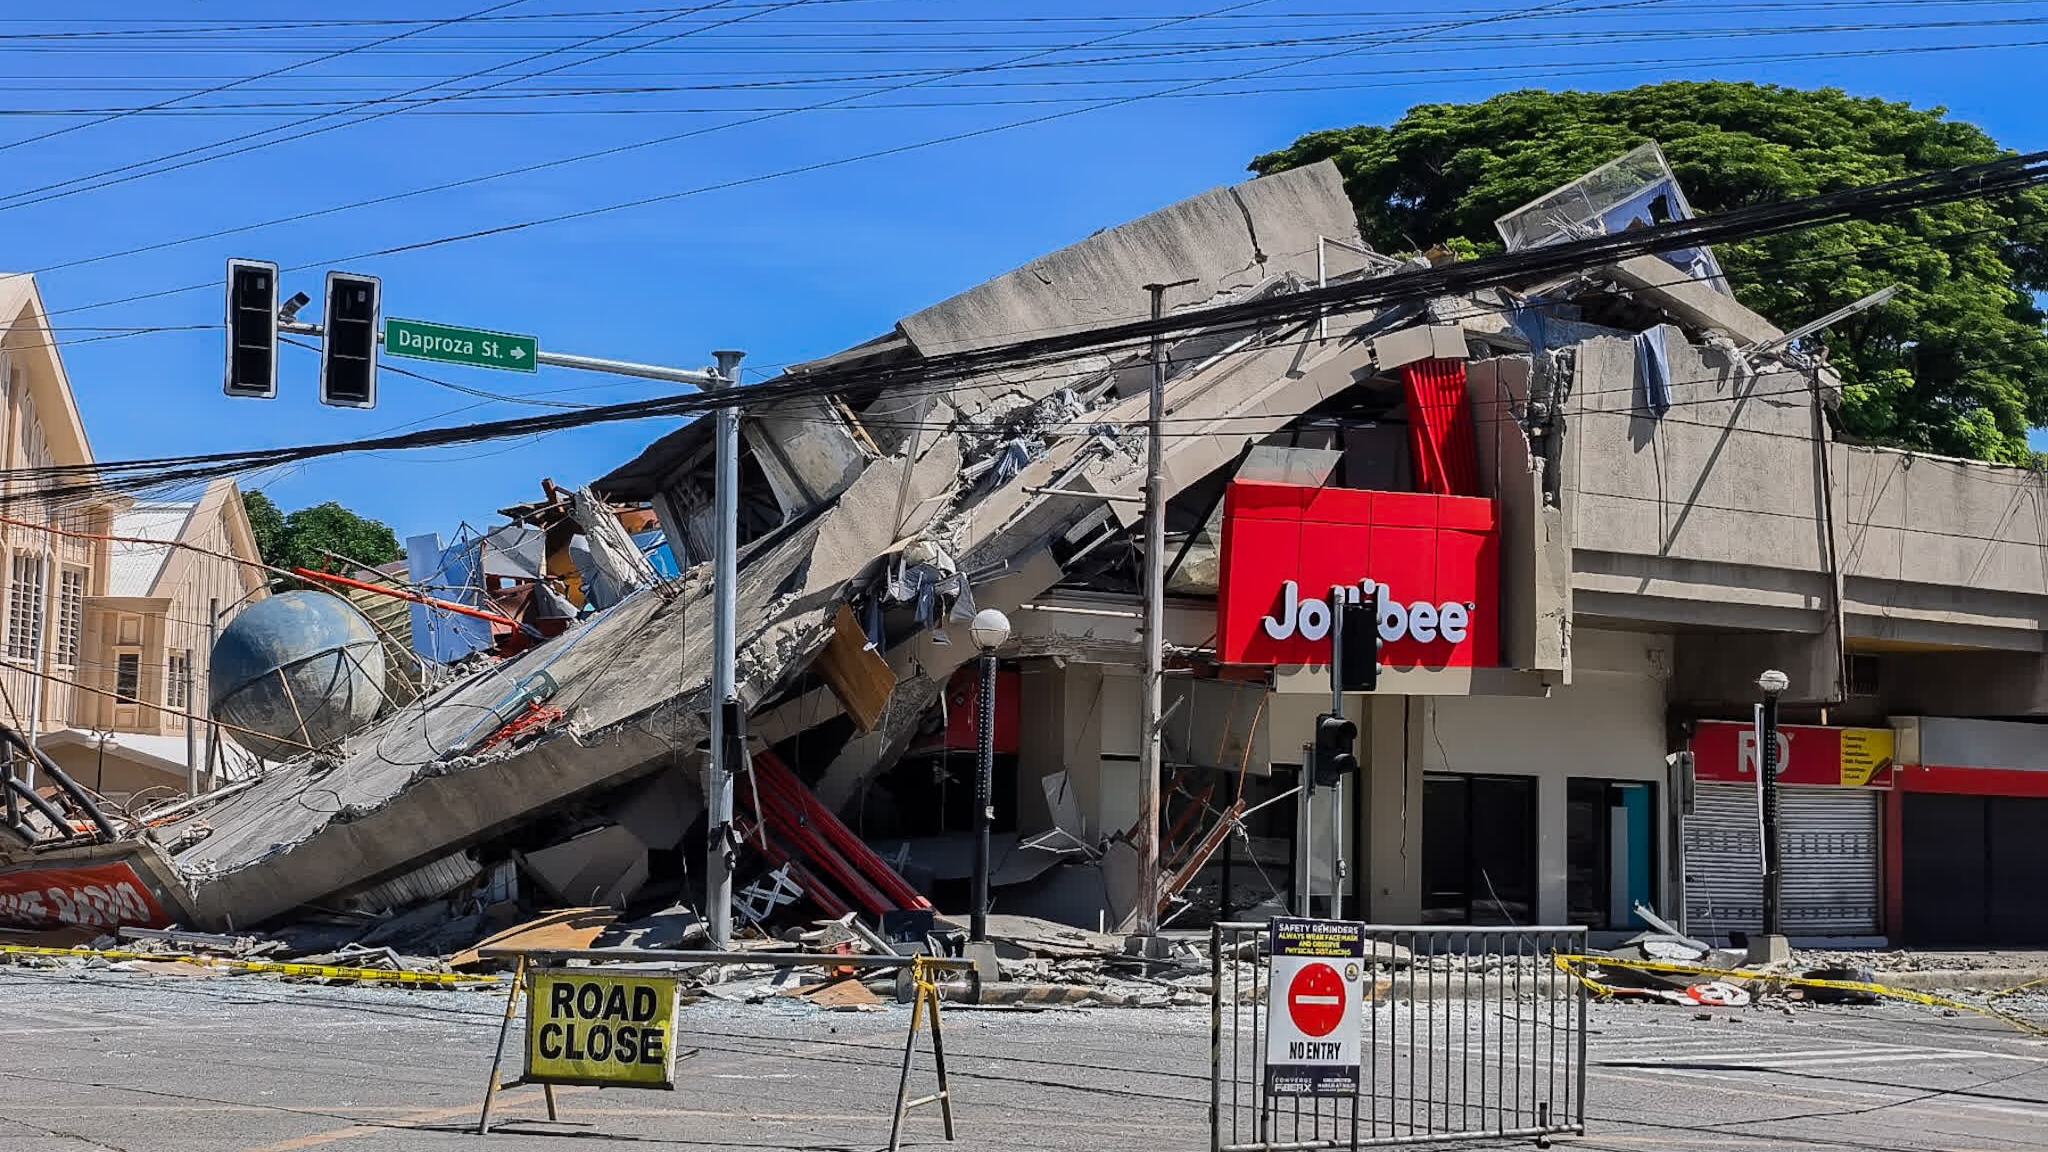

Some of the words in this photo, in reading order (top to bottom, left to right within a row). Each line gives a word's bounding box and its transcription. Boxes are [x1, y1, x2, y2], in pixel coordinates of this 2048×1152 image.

[399, 328, 473, 355] Daproza
[481, 340, 504, 359] St.
[1263, 577, 1470, 644] Jobee
[1278, 932, 1305, 940] ALWAYS
[1279, 923, 1311, 932] SAFETY
[1312, 924, 1359, 934] REMINDERS
[550, 982, 657, 1022] ROAD
[539, 1022, 665, 1064] CLOSE
[1289, 1041, 1304, 1060] NO
[1306, 1042, 1342, 1060] ENTRY
